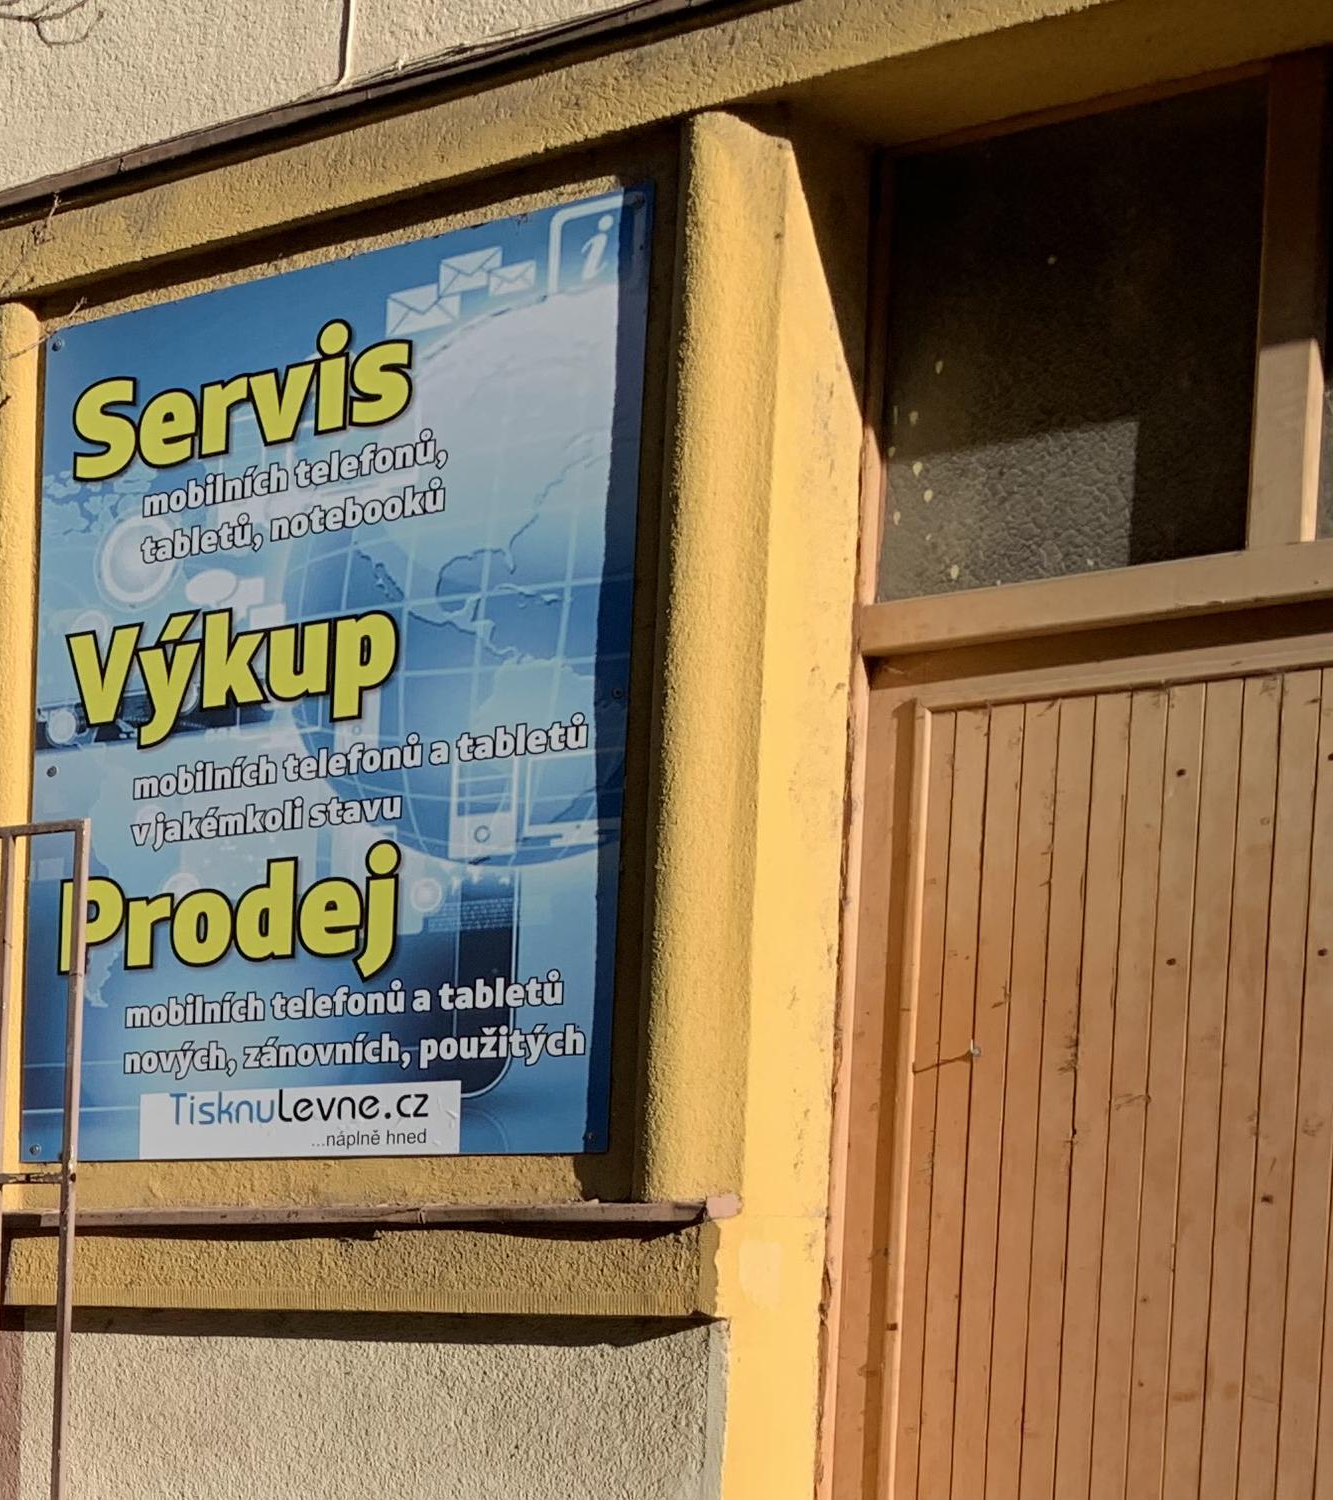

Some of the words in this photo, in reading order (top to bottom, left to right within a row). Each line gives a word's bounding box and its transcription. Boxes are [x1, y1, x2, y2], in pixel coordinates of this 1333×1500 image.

[72, 318, 413, 482] Servis
[142, 461, 289, 519] mobilních
[295, 428, 449, 488] telefonů,
[140, 514, 263, 564] tabletů,
[269, 477, 447, 542] notebooků
[66, 608, 399, 748] Výkup
[133, 751, 278, 800] mobilních
[283, 732, 423, 784] telefonů
[430, 740, 450, 766] a
[456, 713, 589, 760] tabletů
[131, 821, 150, 847] v
[150, 798, 304, 851] jakémkoli
[308, 794, 403, 828] stavu
[58, 840, 402, 982] Prodej
[124, 982, 266, 1030] mobilních
[271, 979, 407, 1020] telefonů
[412, 989, 430, 1014] a
[438, 970, 564, 1010] tabletů
[124, 1040, 239, 1080] nových,
[243, 1033, 411, 1071] zánovních,
[419, 1024, 586, 1068] použitých
[170, 1089, 430, 1127] TisknuLevne.cz
[386, 1127, 427, 1147] hned
